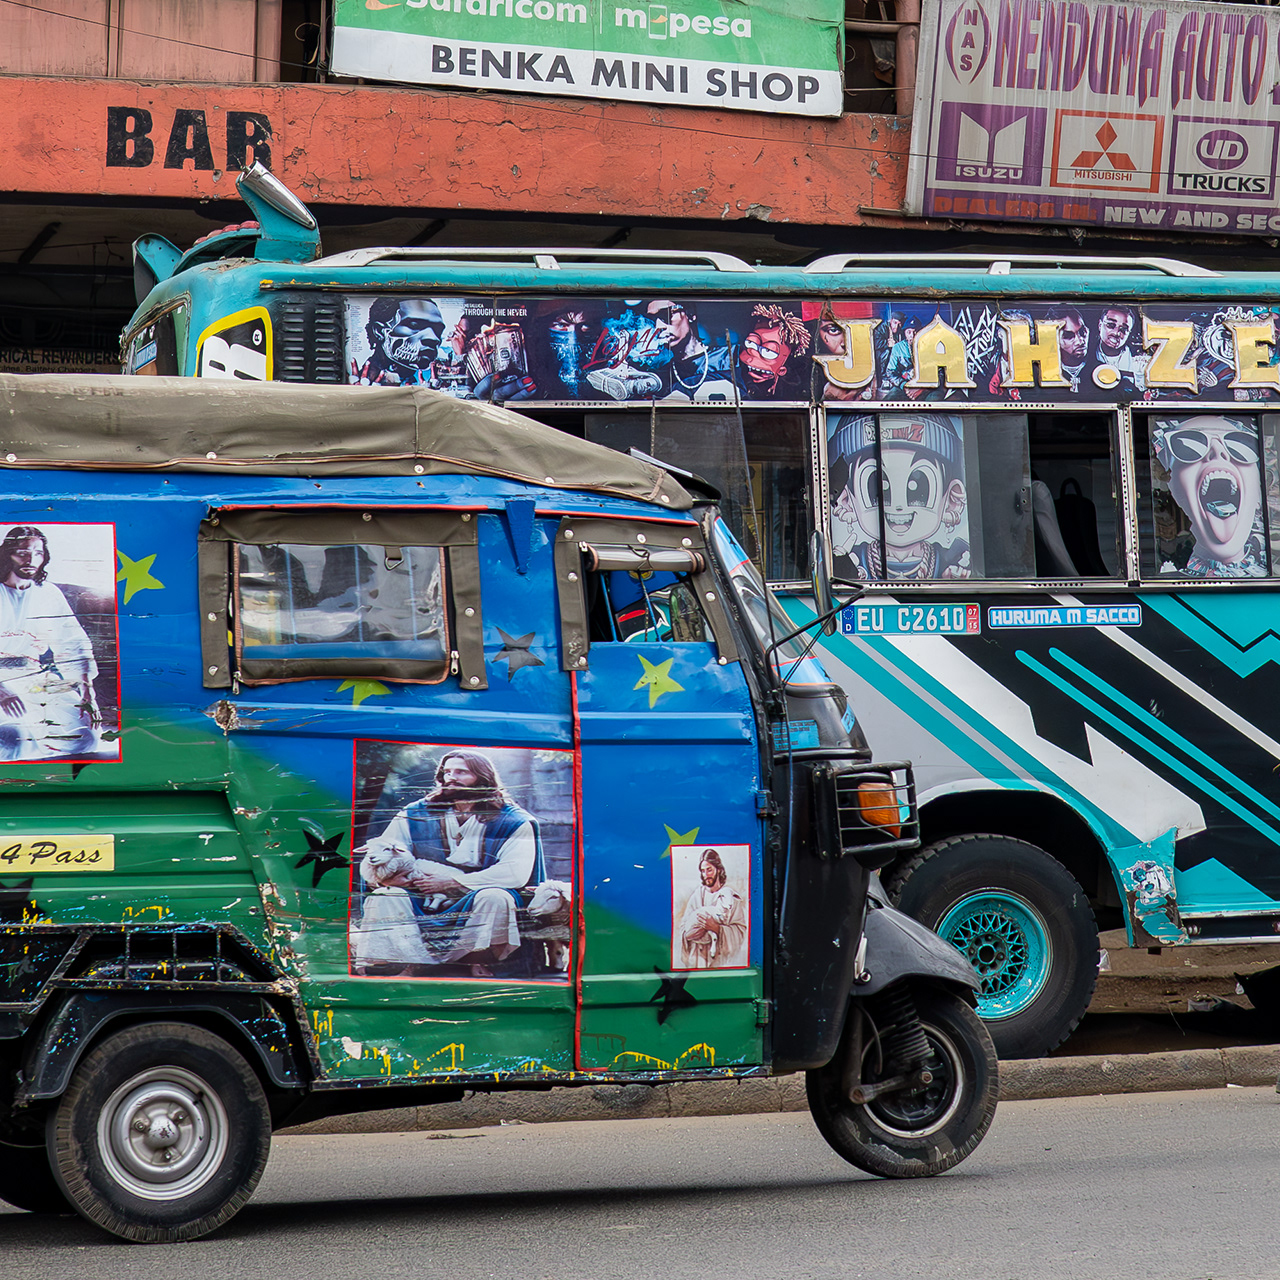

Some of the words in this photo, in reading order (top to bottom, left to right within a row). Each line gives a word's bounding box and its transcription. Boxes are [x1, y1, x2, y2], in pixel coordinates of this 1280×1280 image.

[1171, 9, 1269, 111] AUTO
[431, 43, 575, 85] BENKA
[591, 57, 689, 95] MINI
[706, 68, 819, 104] SHOP
[106, 104, 273, 172] BAR
[1200, 139, 1245, 160] UD
[955, 166, 1023, 179] ISUZU
[1073, 170, 1133, 182] MITSUBISHI
[1178, 173, 1266, 193] TRUCKS
[1104, 205, 1166, 224] NEW
[1171, 211, 1231, 228] AND
[464, 308, 494, 316] THROUGH
[41, 349, 120, 366] REWINDERS
[857, 608, 884, 631] EU
[897, 607, 964, 632] C2610
[968, 608, 977, 616] 07
[991, 610, 1061, 625] HURUMA
[1067, 610, 1080, 624] M
[1086, 608, 1139, 624] SACCO
[845, 624, 852, 632] D
[0, 844, 22, 865] 4
[28, 842, 103, 866] Pass
